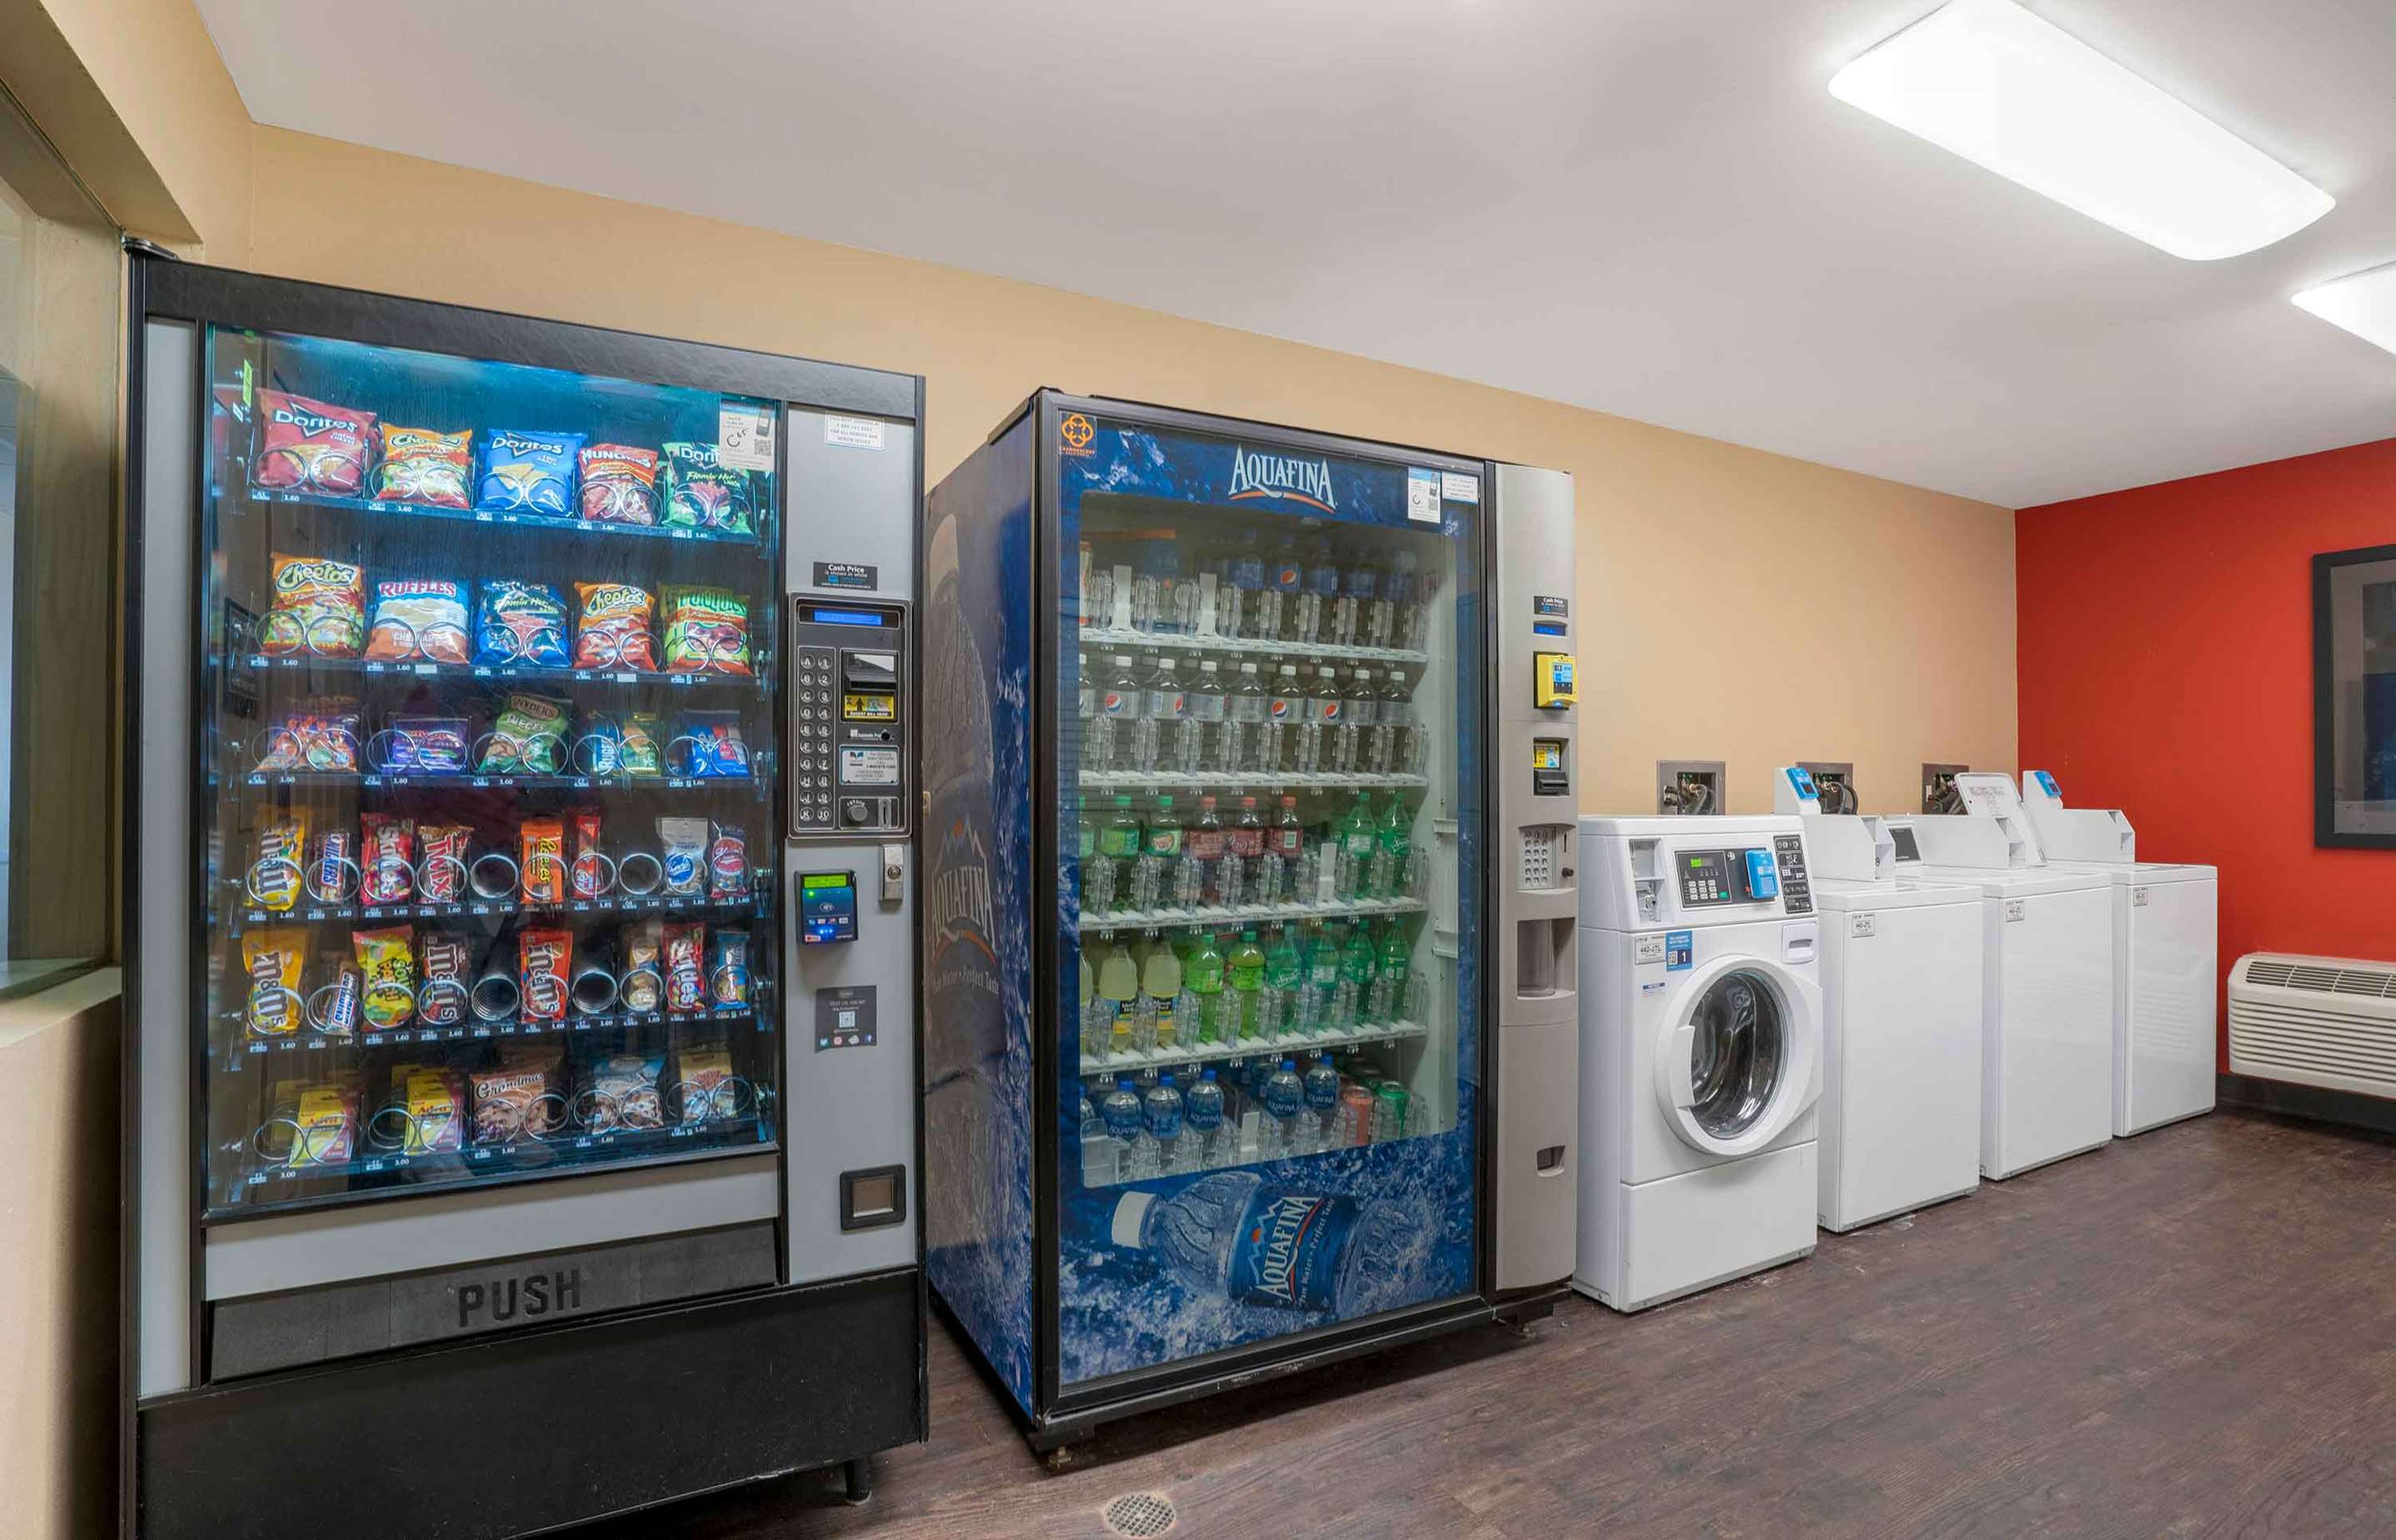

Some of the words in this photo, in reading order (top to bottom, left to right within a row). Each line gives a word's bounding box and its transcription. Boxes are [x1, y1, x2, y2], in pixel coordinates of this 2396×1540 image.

[275, 409, 358, 433] Doritos
[492, 437, 564, 455] Doritos
[681, 447, 719, 463] Dorit
[1228, 443, 1337, 510] AQUAFINA
[277, 562, 356, 591] Cheetos
[379, 581, 457, 597] RUFFLES
[424, 834, 454, 899] TWIX
[931, 863, 999, 959] AQUAFINA
[1682, 951, 1686, 963] 1
[1256, 1196, 1322, 1302] AQUAFINA
[459, 1269, 581, 1329] PUSH
